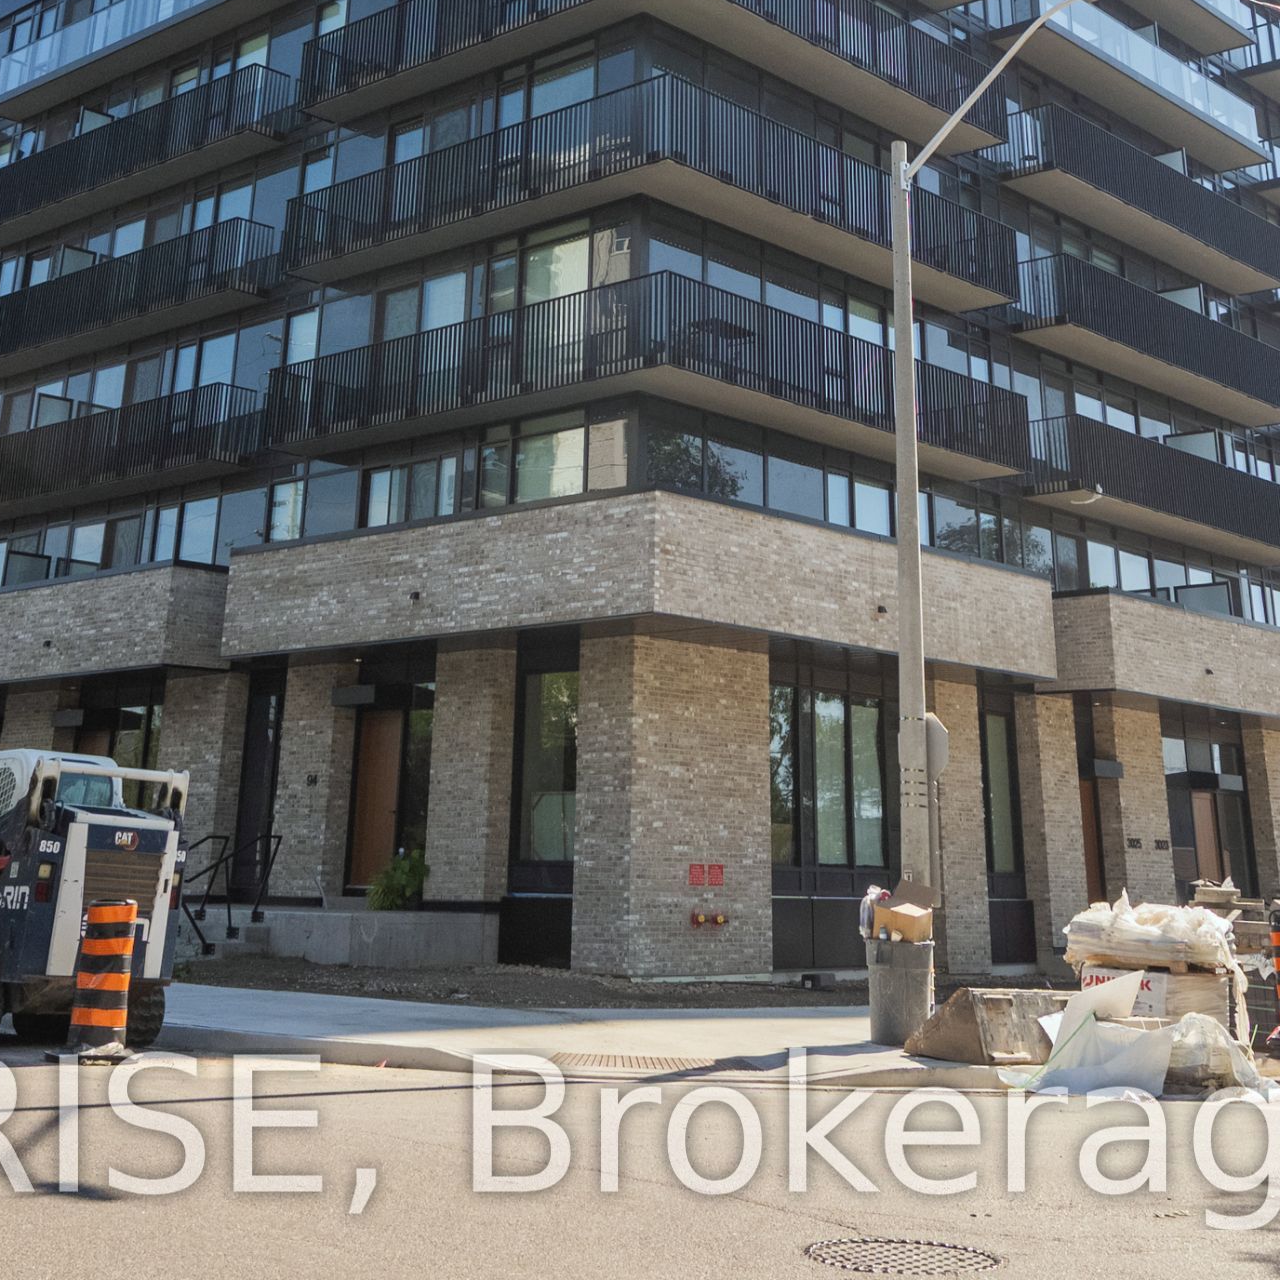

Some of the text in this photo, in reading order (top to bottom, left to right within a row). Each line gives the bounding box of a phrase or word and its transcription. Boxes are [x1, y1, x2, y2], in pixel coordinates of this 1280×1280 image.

[115, 831, 134, 845] CAT
[39, 840, 61, 854] 850
[176, 850, 187, 862] 50
